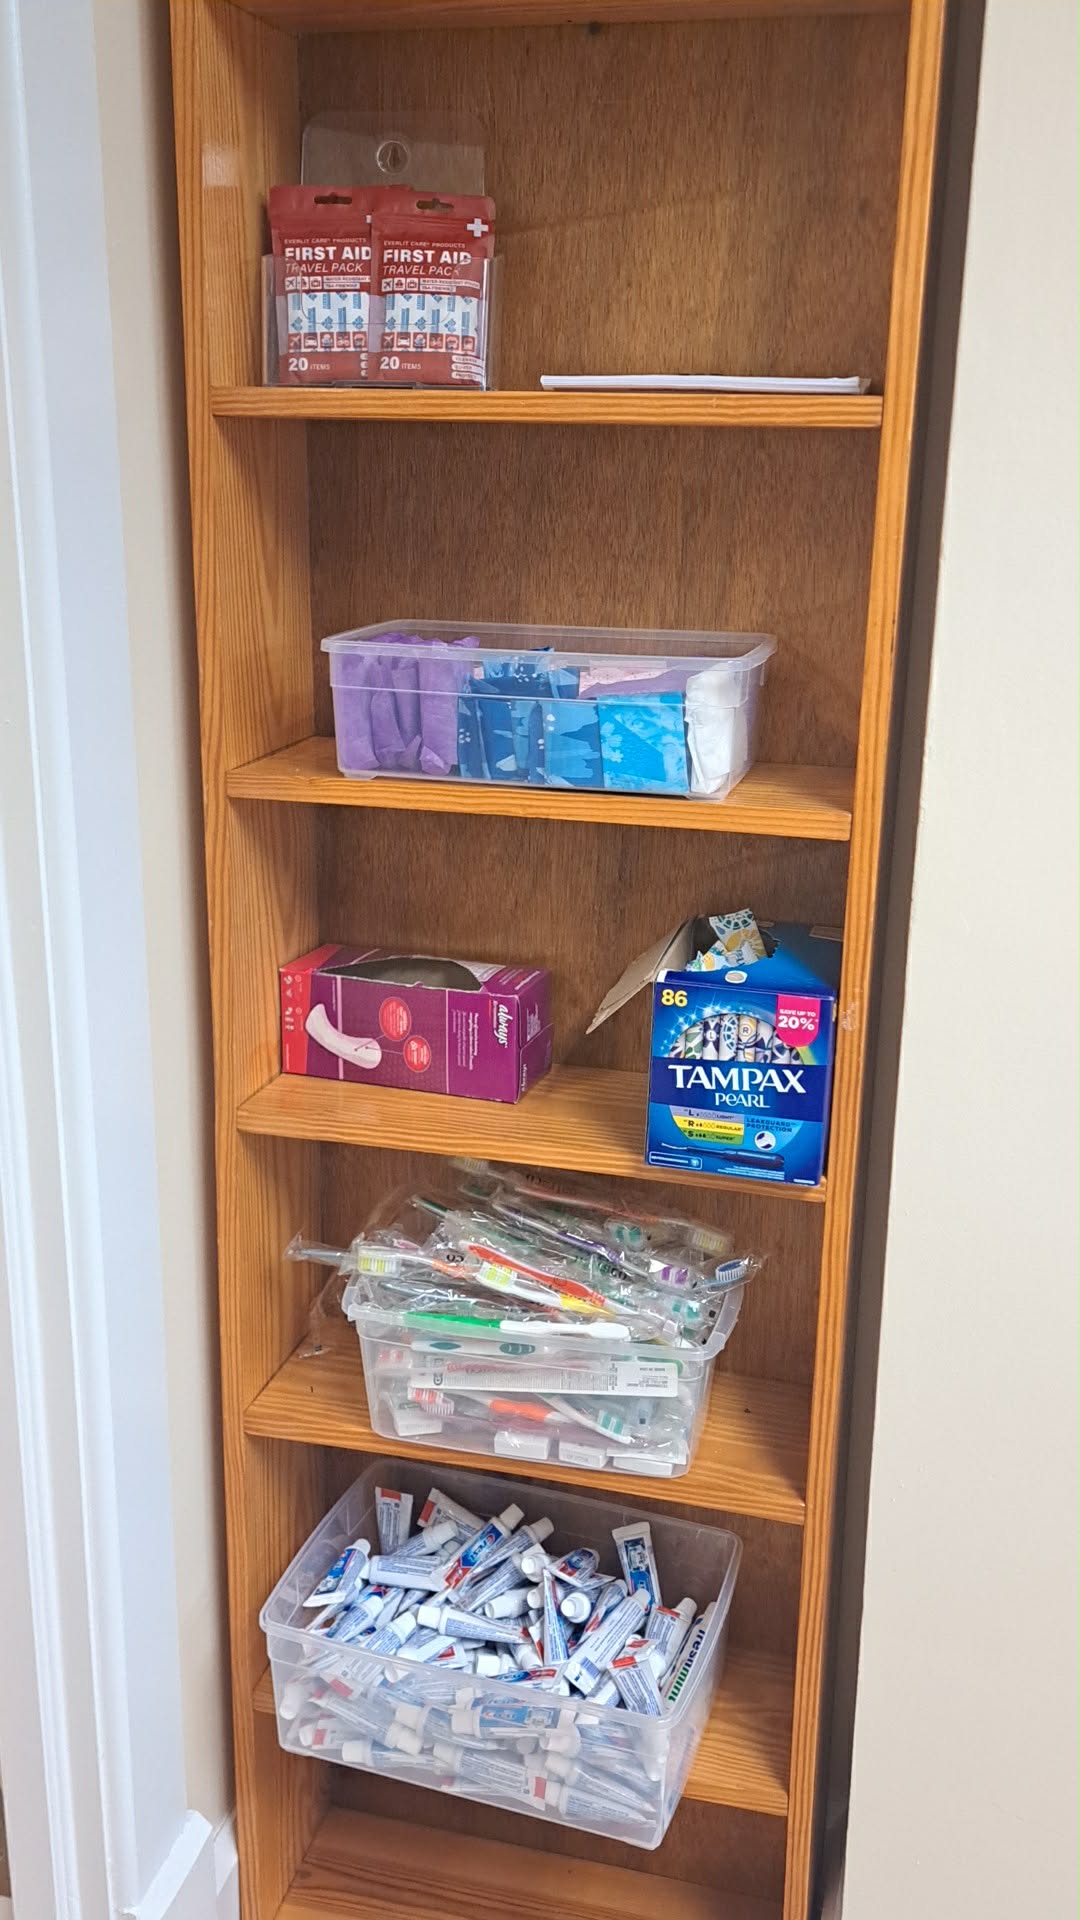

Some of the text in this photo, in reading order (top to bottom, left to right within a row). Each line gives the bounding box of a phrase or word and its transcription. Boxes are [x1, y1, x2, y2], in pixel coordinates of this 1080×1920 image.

[285, 246, 371, 261] FIRST AID
[384, 249, 472, 265] FIRST AID
[286, 263, 364, 274] TRAVEL PACK
[383, 265, 427, 275] TRAVEL
[288, 357, 308, 371] 20
[380, 356, 400, 370] 20
[661, 989, 688, 1007] 86
[494, 1004, 513, 1045] always
[778, 1015, 815, 1031] 20%
[668, 1064, 807, 1094] TAMPAX
[687, 1119, 695, 1128] R
[746, 1123, 793, 1133] PROTECTION
